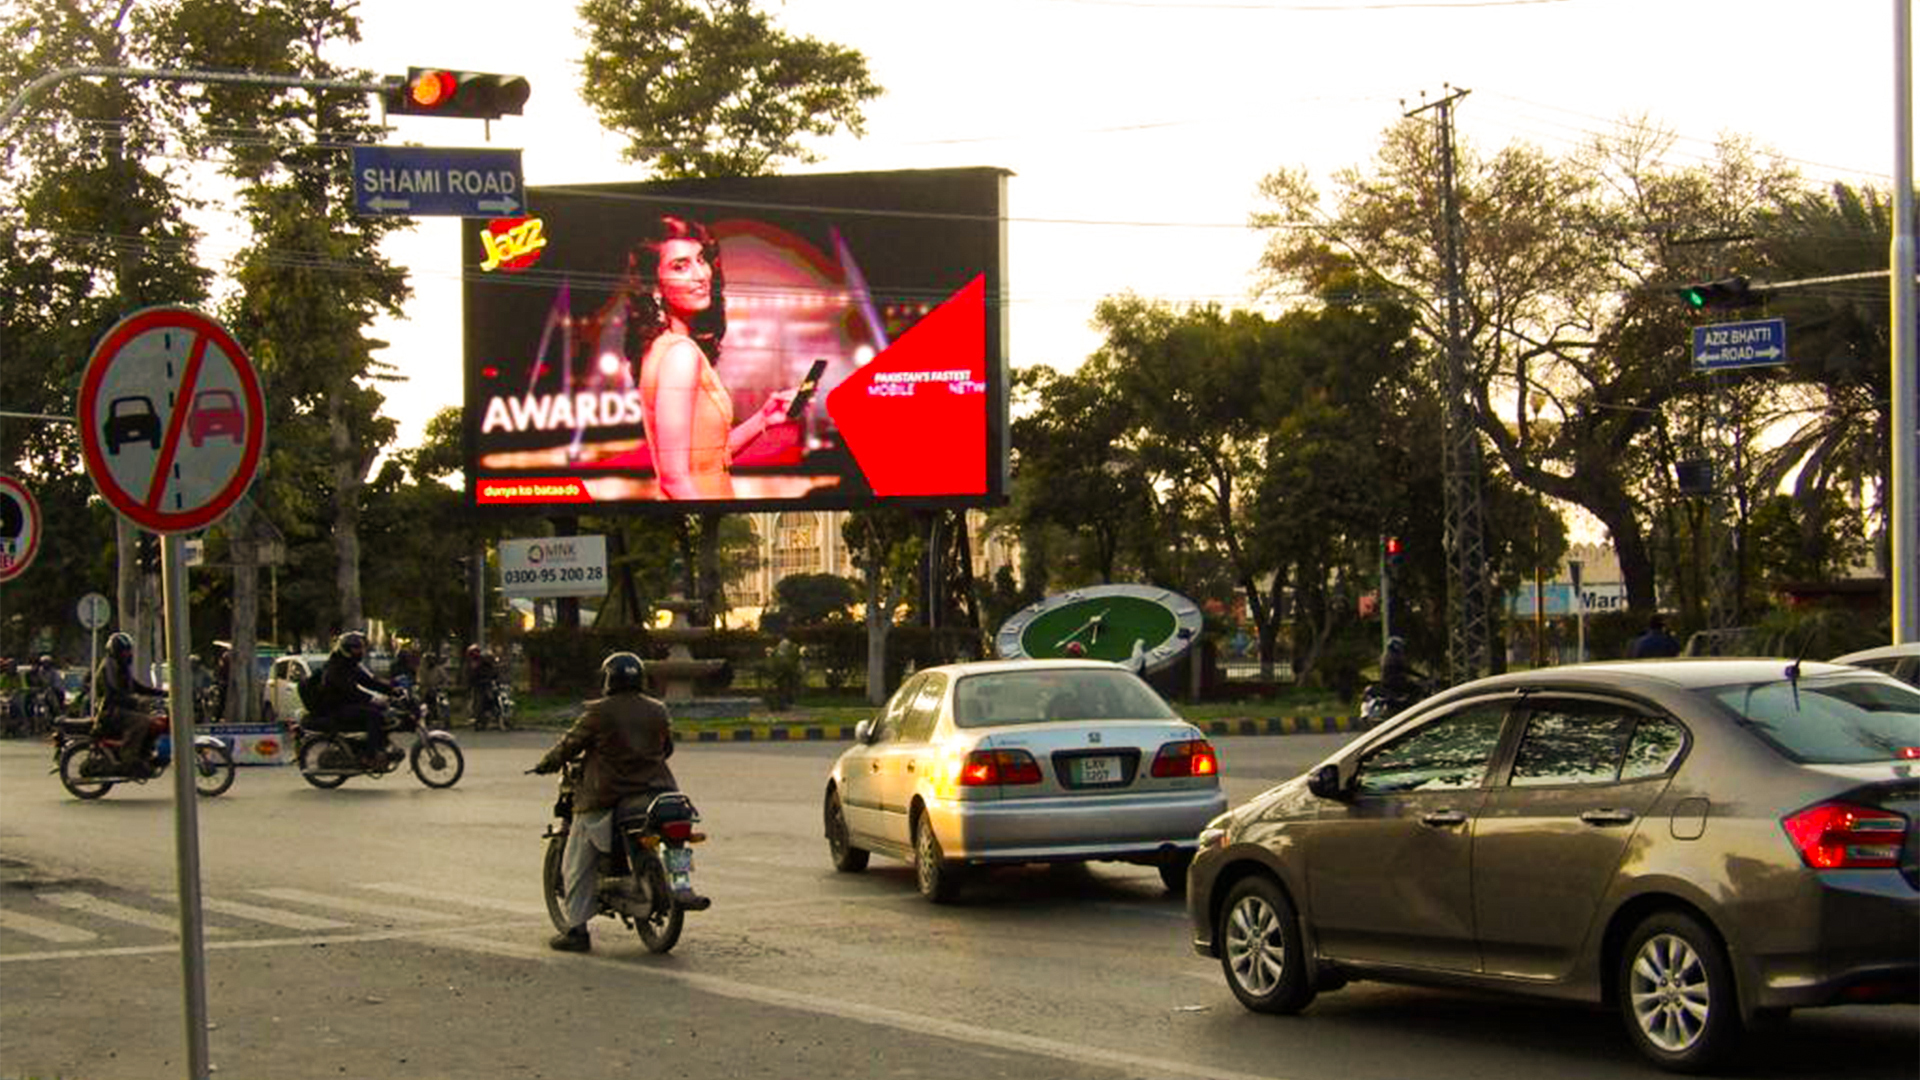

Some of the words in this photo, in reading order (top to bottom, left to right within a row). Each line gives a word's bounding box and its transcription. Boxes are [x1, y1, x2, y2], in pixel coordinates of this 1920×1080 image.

[362, 168, 441, 194] SHAMI
[449, 170, 517, 194] ROAD
[479, 217, 548, 272] Jazz
[1704, 329, 1729, 345] AZIZ
[1731, 326, 1771, 344] BHATTI
[1721, 345, 1754, 361] ROAD
[931, 368, 972, 382] FASTEST
[867, 383, 916, 397] MOBILE
[480, 391, 643, 434] AWARDS
[518, 485, 533, 496] ko
[504, 568, 557, 585] 0300-95
[559, 567, 584, 581] 200
[586, 565, 603, 580] 28
